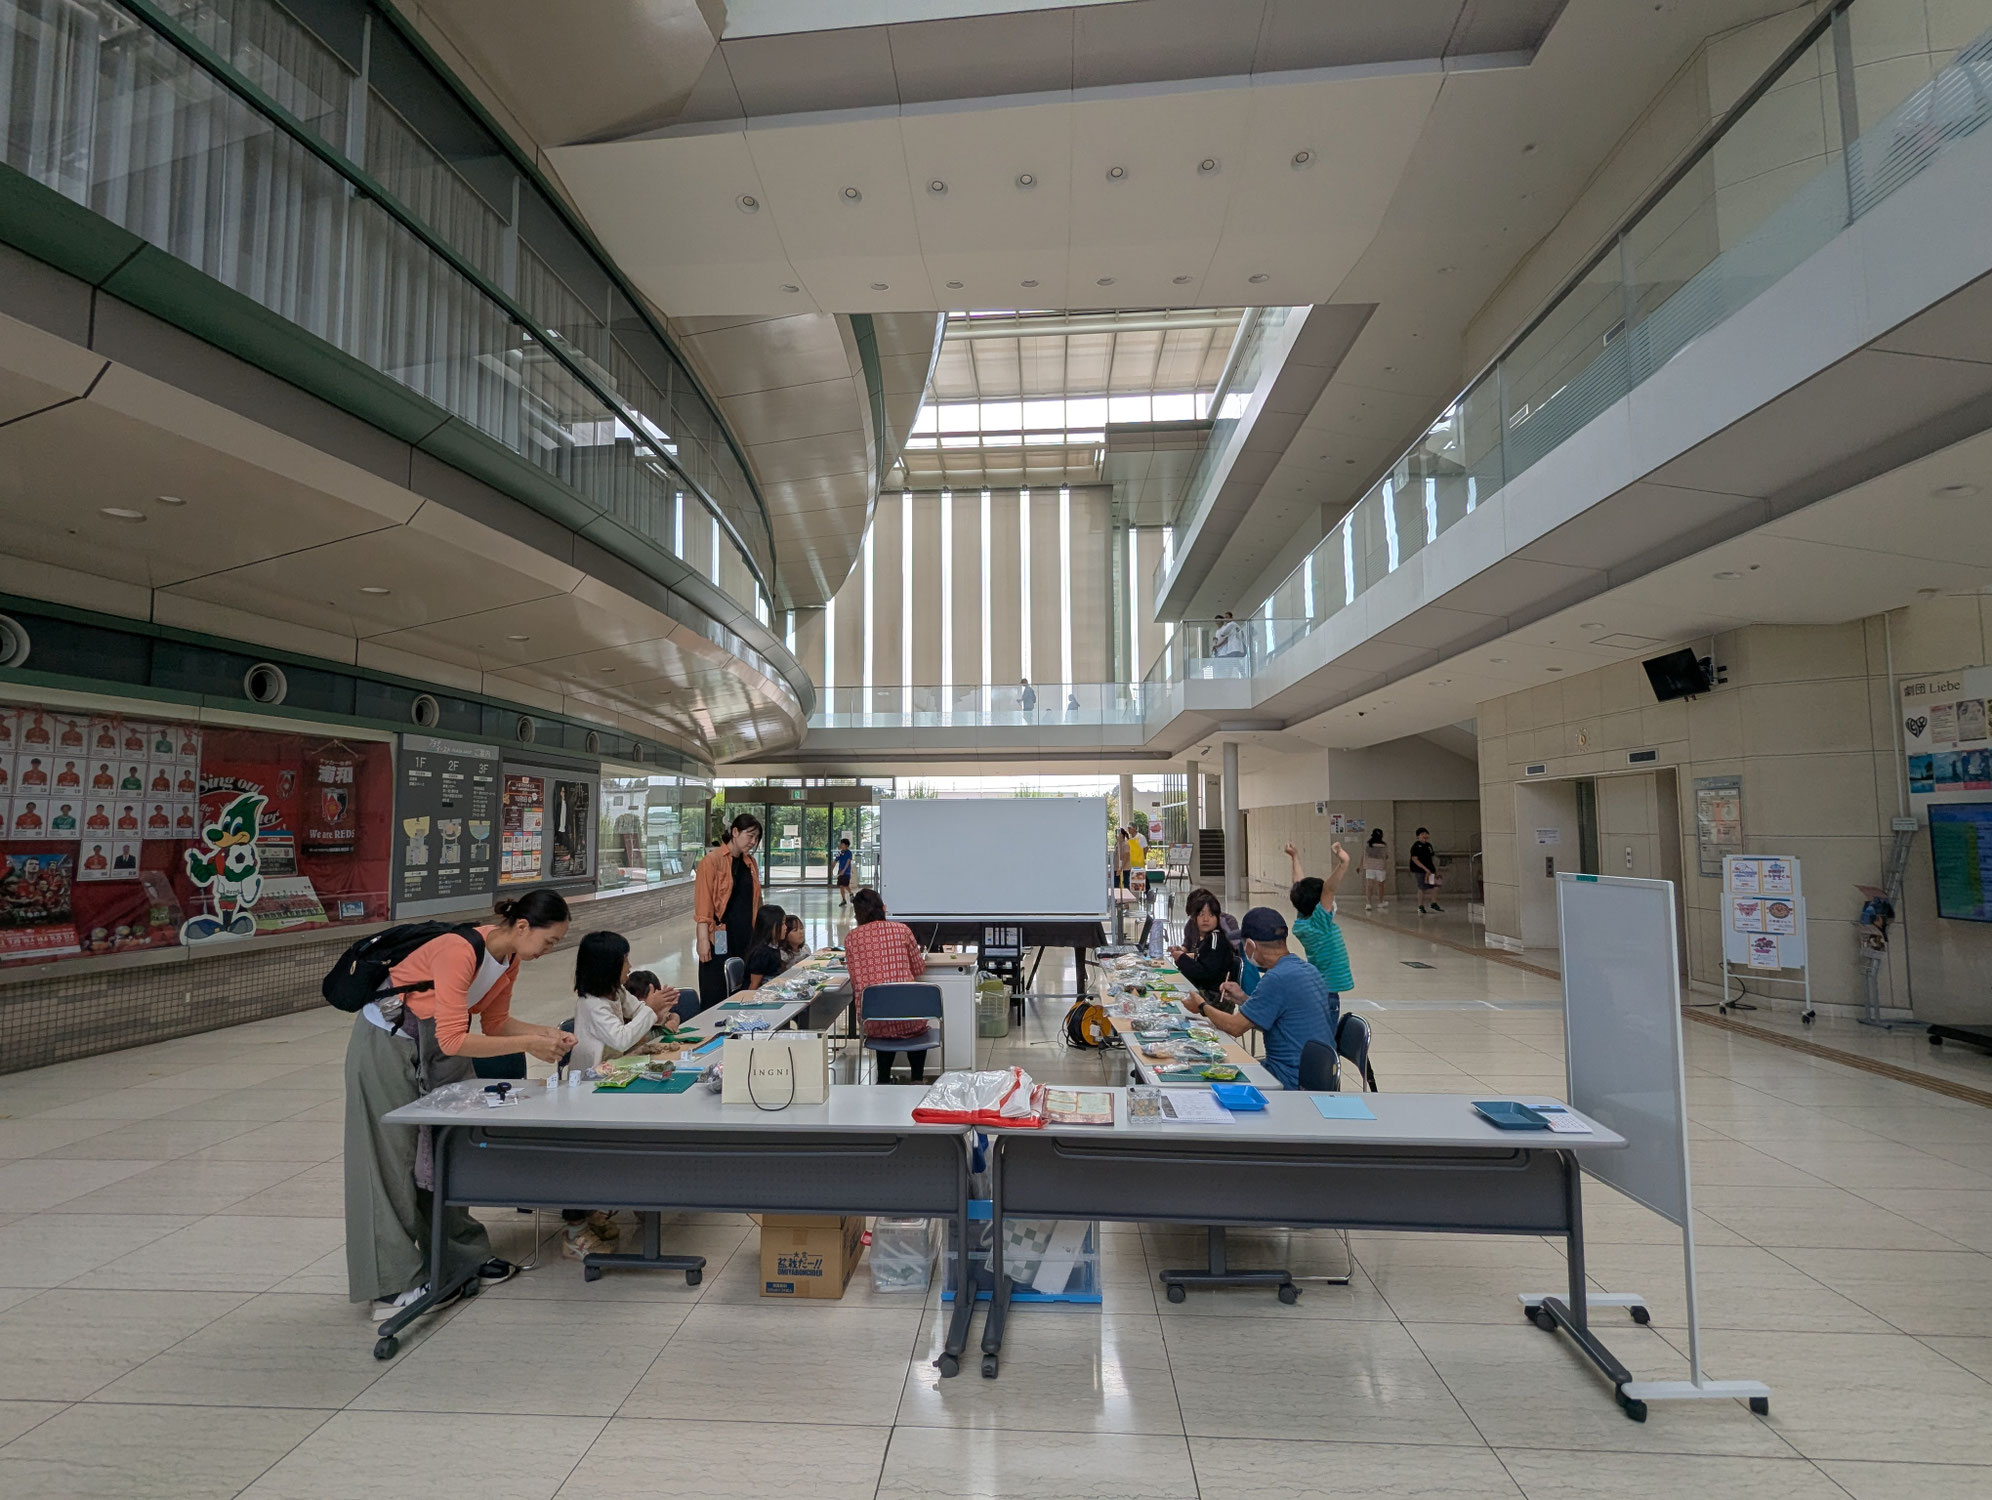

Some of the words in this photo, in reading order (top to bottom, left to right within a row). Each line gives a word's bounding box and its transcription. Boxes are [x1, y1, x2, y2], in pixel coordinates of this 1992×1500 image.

[1904, 683, 1926, 697] 劇団
[1929, 680, 1961, 694] Liebe
[415, 756, 427, 768] 1F
[448, 760, 460, 771] 2F
[478, 763, 489, 774] 3F
[309, 829, 322, 839] We
[322, 831, 333, 839] are
[753, 1068, 789, 1076] INGNI
